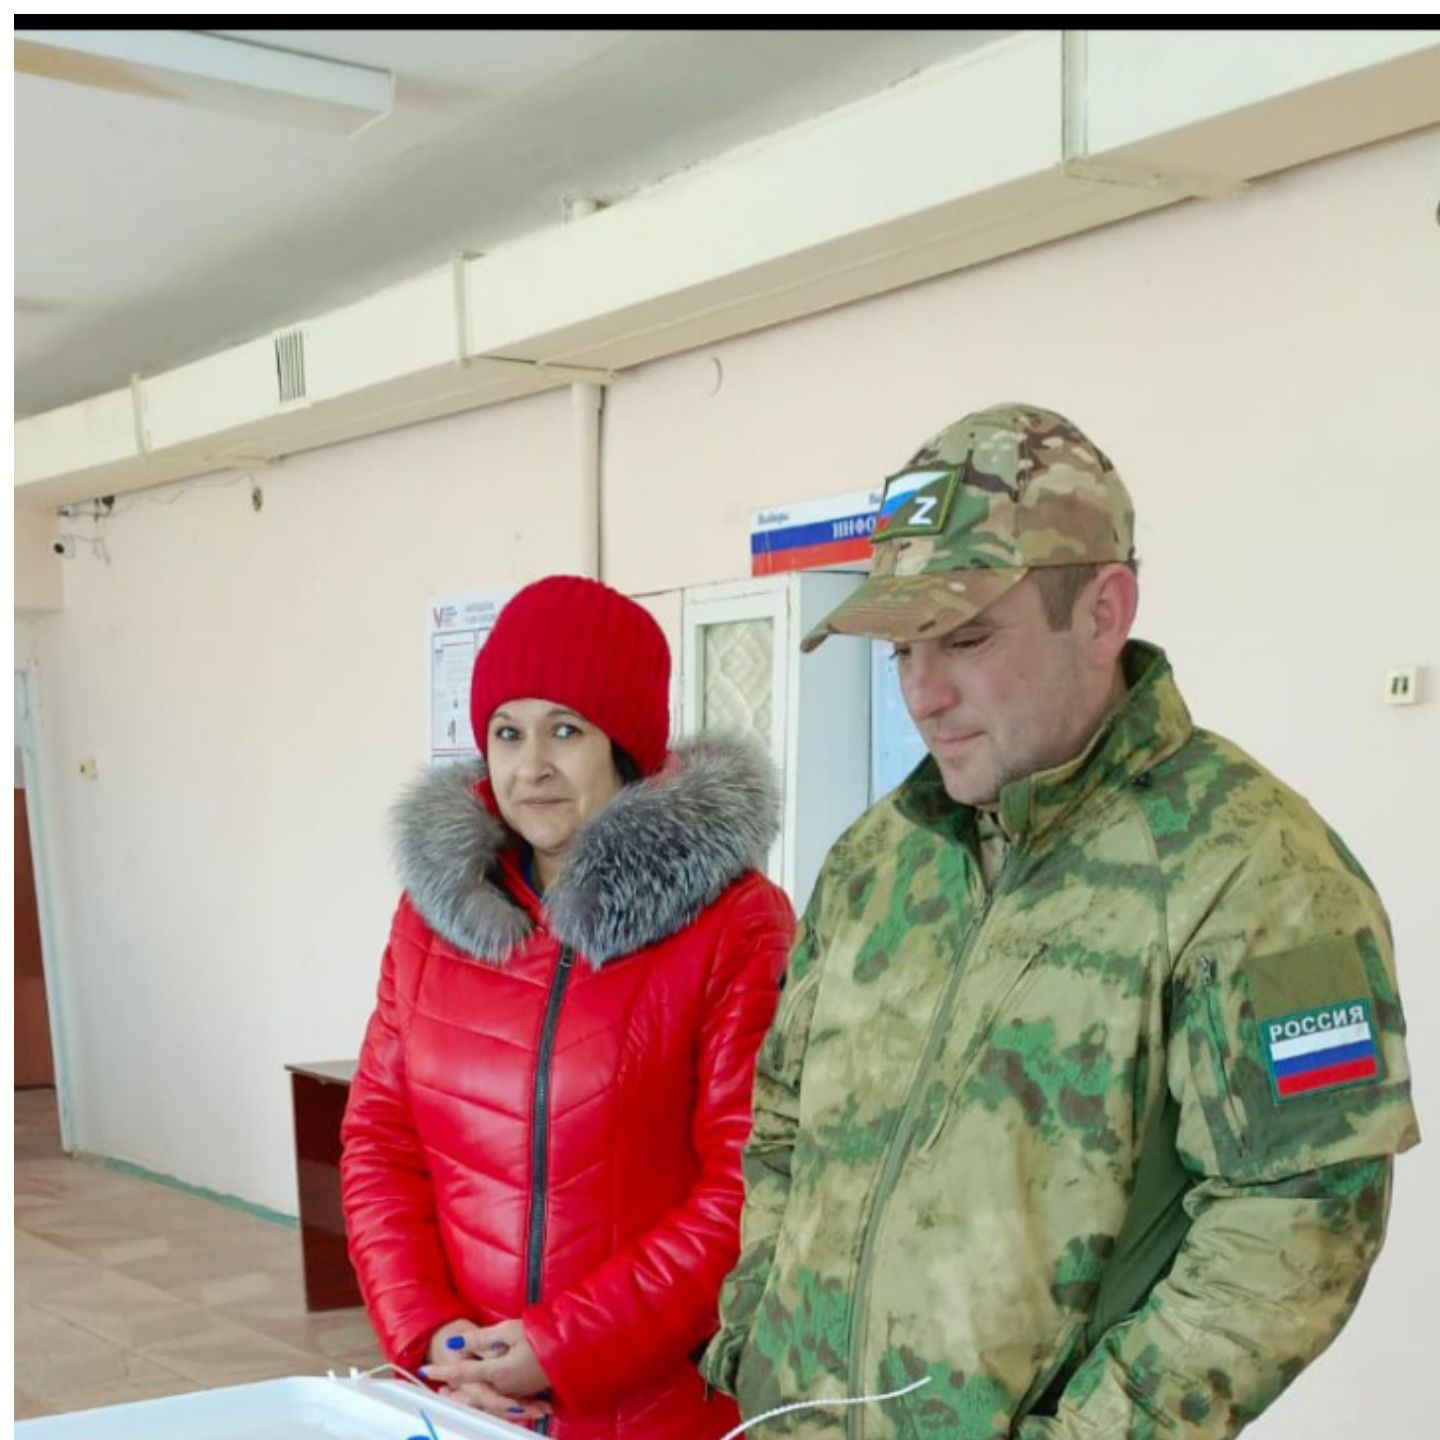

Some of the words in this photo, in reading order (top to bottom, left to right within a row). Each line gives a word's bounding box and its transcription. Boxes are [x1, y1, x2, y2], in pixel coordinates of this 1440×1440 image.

[908, 496, 938, 526] Z
[833, 514, 876, 540] ИНФО
[1269, 1005, 1365, 1043] РОССИЯ
